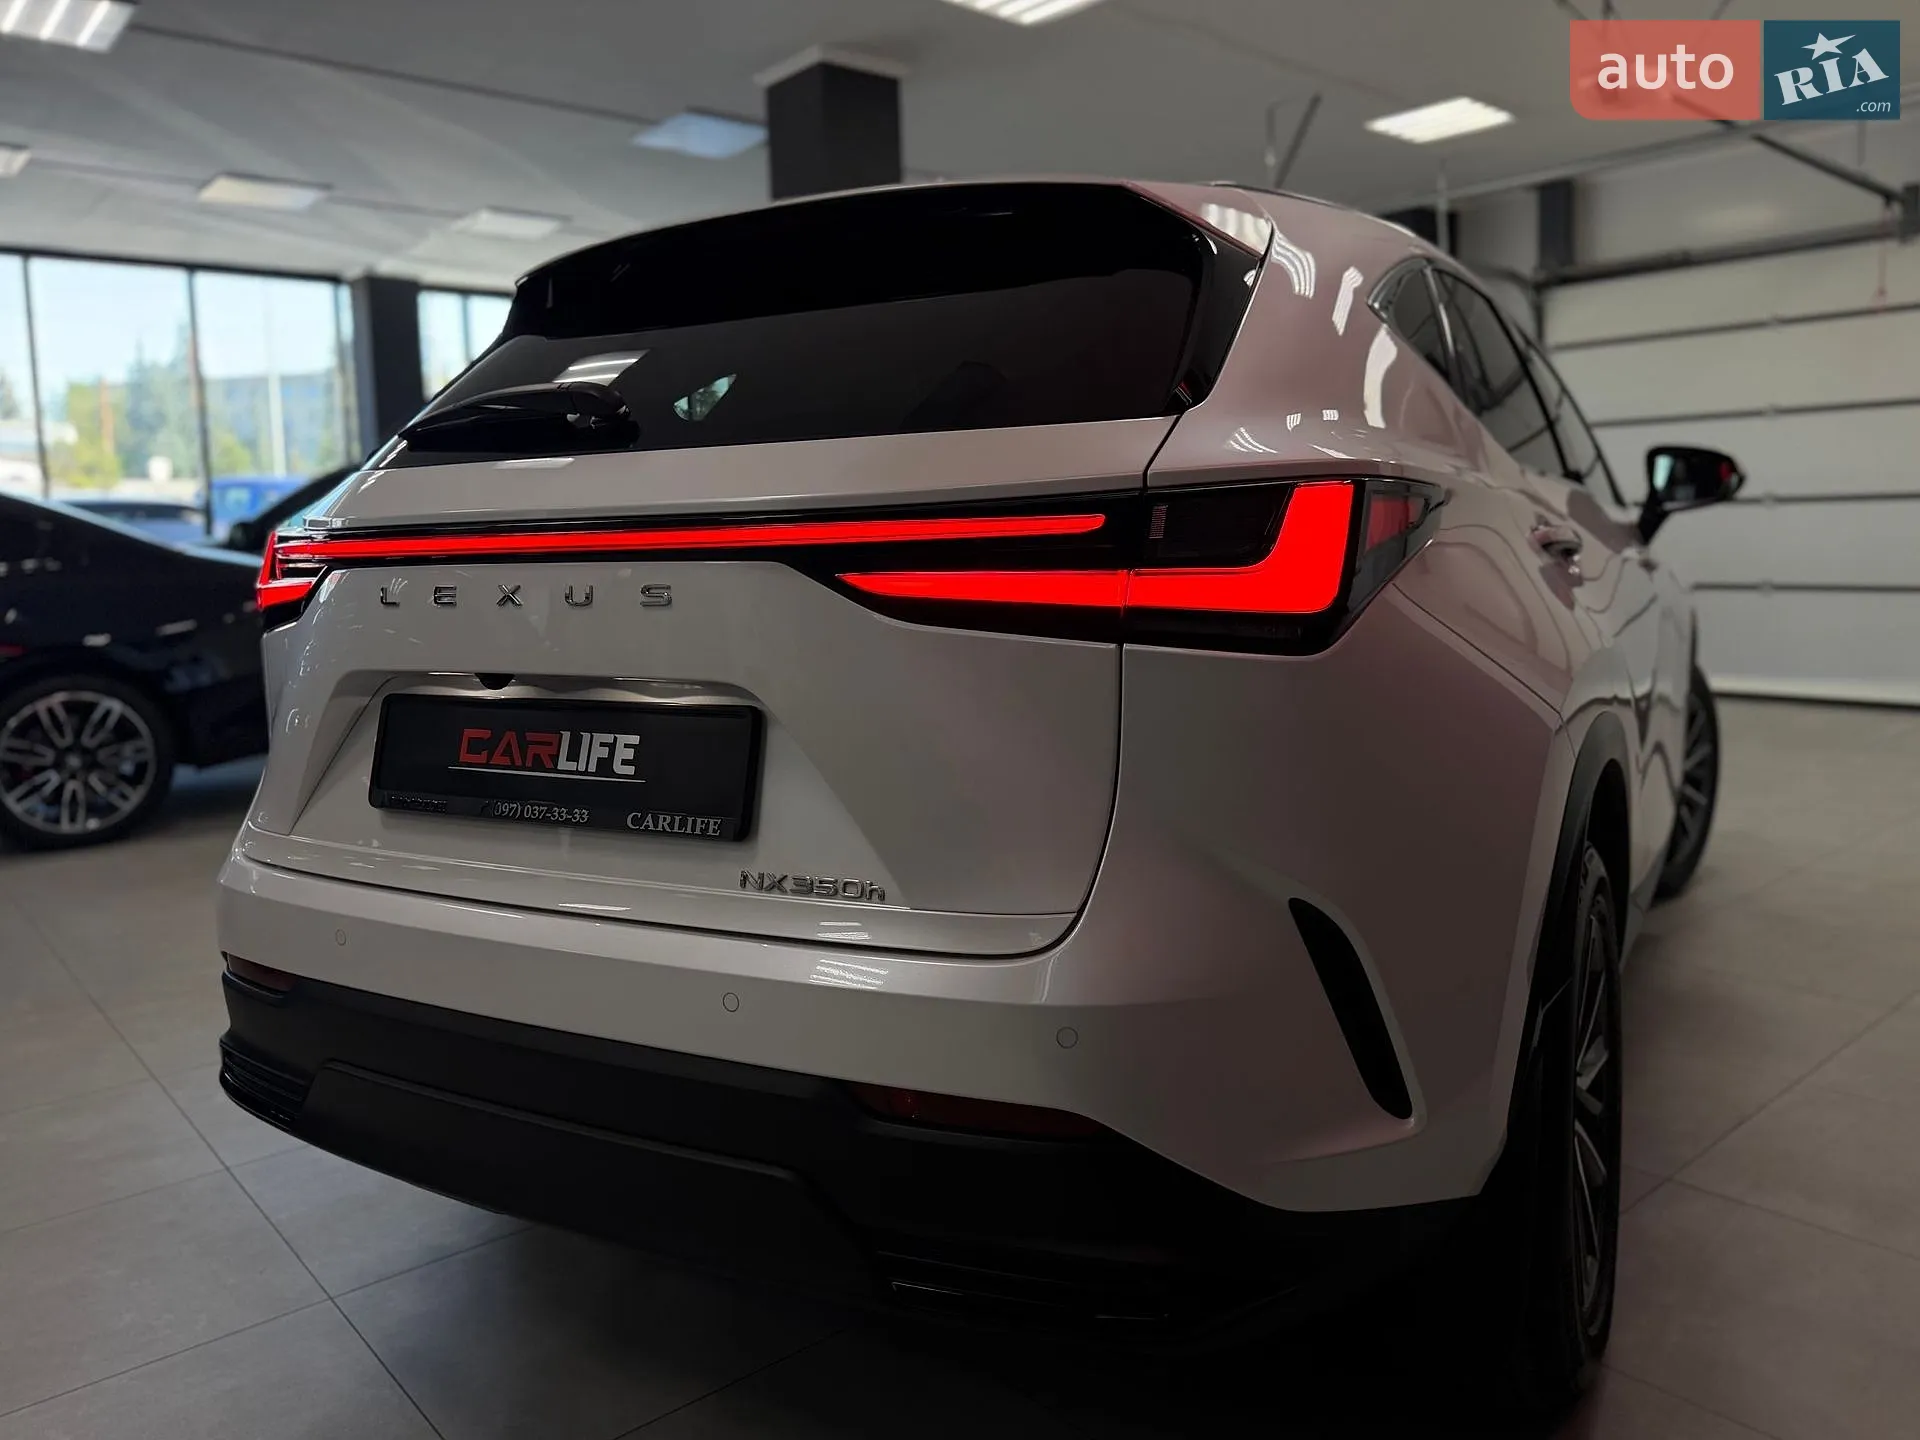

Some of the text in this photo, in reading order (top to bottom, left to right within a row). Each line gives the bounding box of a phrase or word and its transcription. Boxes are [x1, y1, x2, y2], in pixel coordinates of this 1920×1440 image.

[379, 584, 672, 607] LEXUS
[458, 728, 641, 775] CARLIFE
[523, 804, 590, 824] 037-33-33
[625, 812, 722, 837] CARLIFE
[739, 869, 886, 901] NX350h
